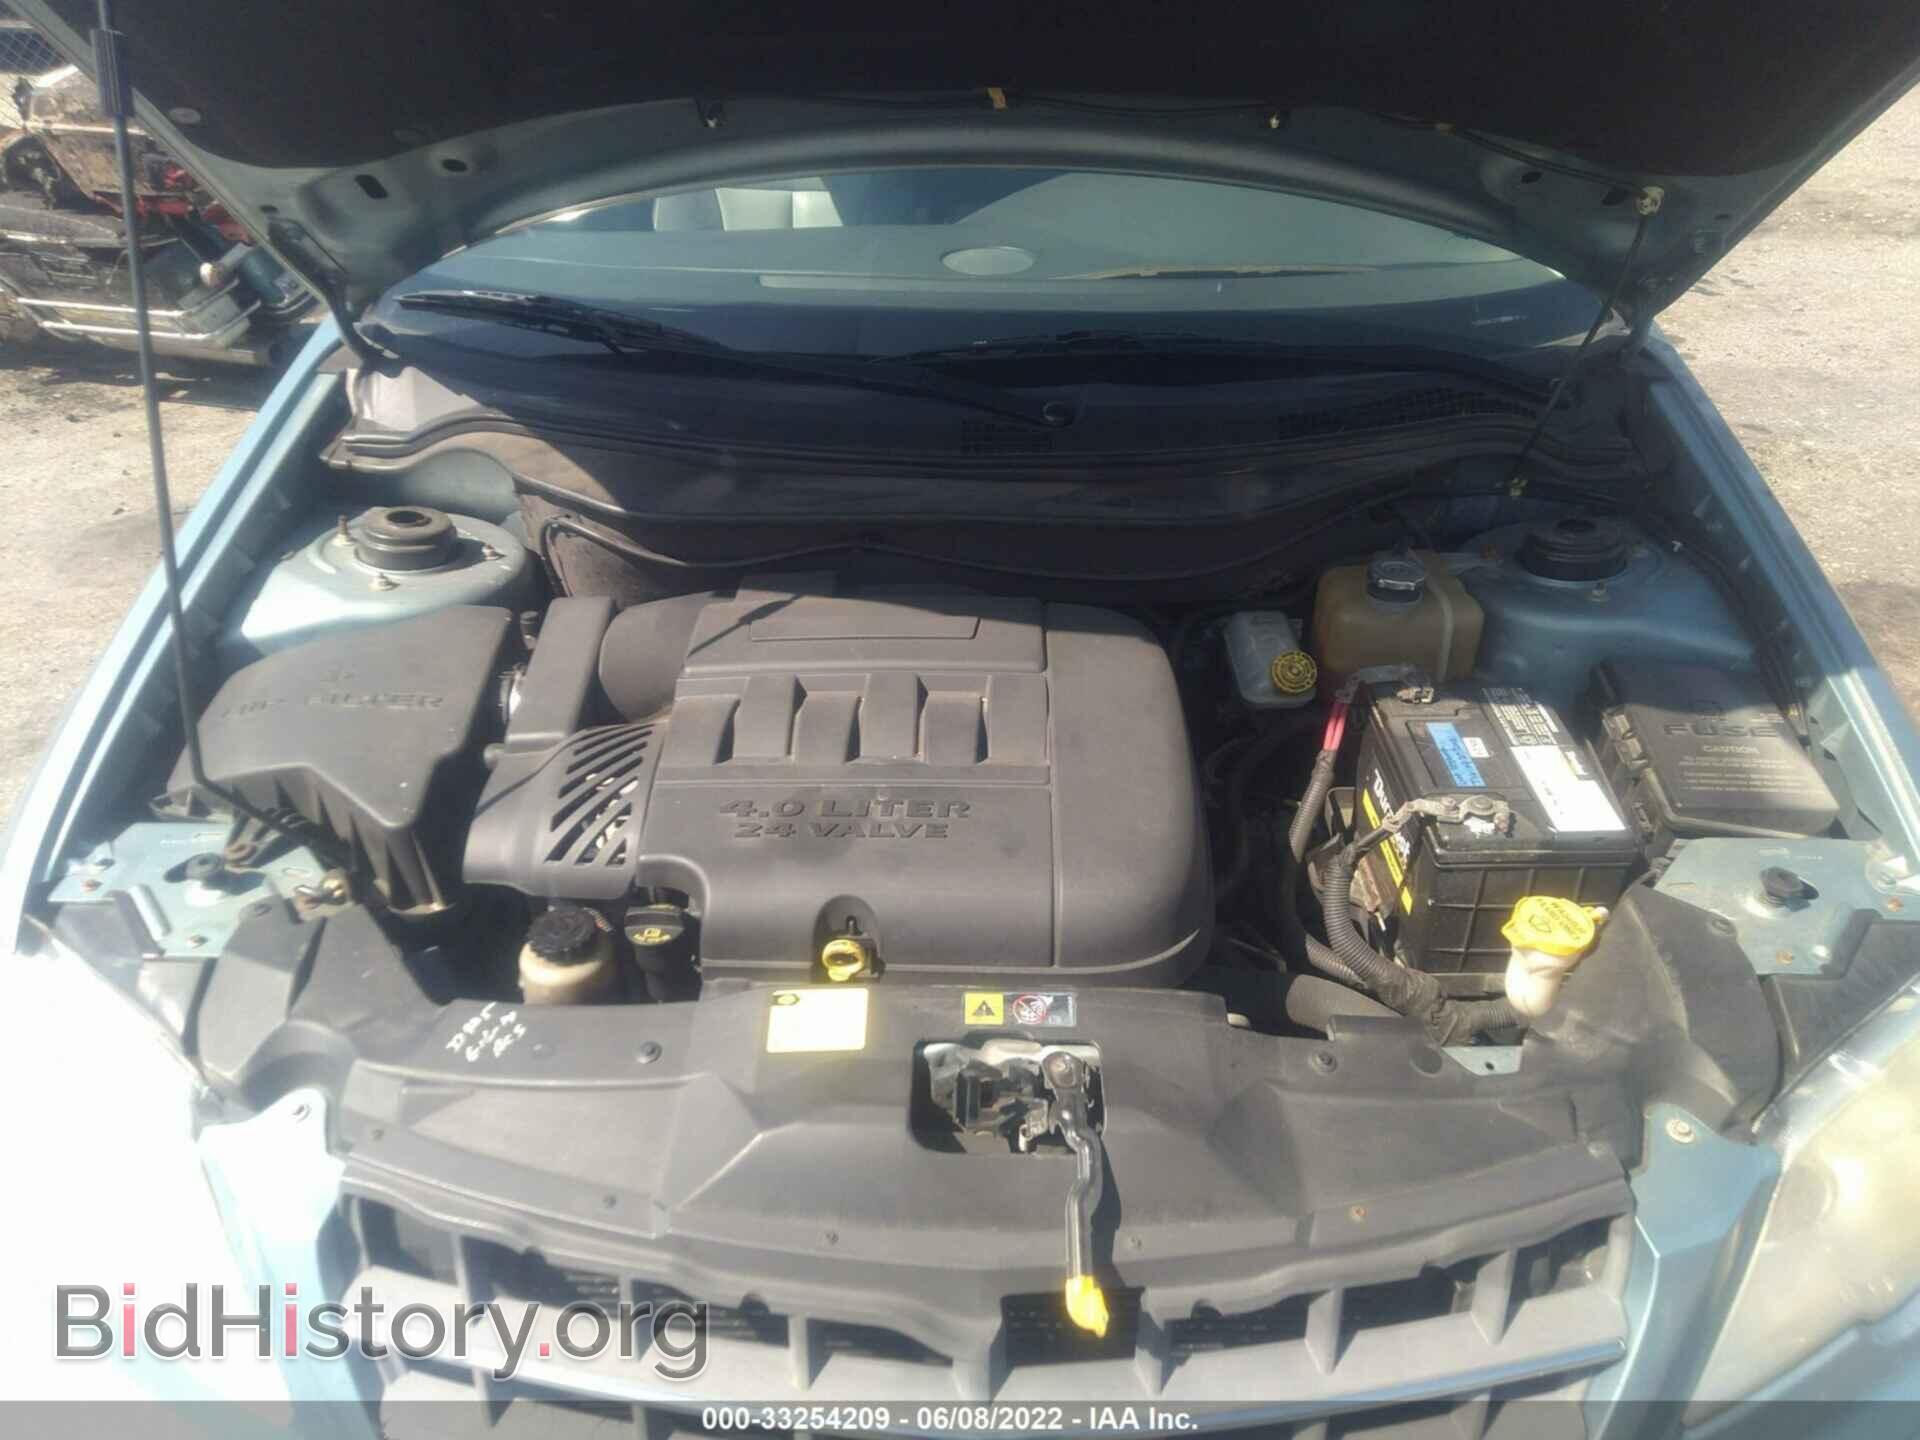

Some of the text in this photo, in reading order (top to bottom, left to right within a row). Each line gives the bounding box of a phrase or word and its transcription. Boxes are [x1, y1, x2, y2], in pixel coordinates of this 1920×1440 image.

[719, 799, 971, 819] 4.0 LITER
[733, 822, 949, 839] 24 VALVE
